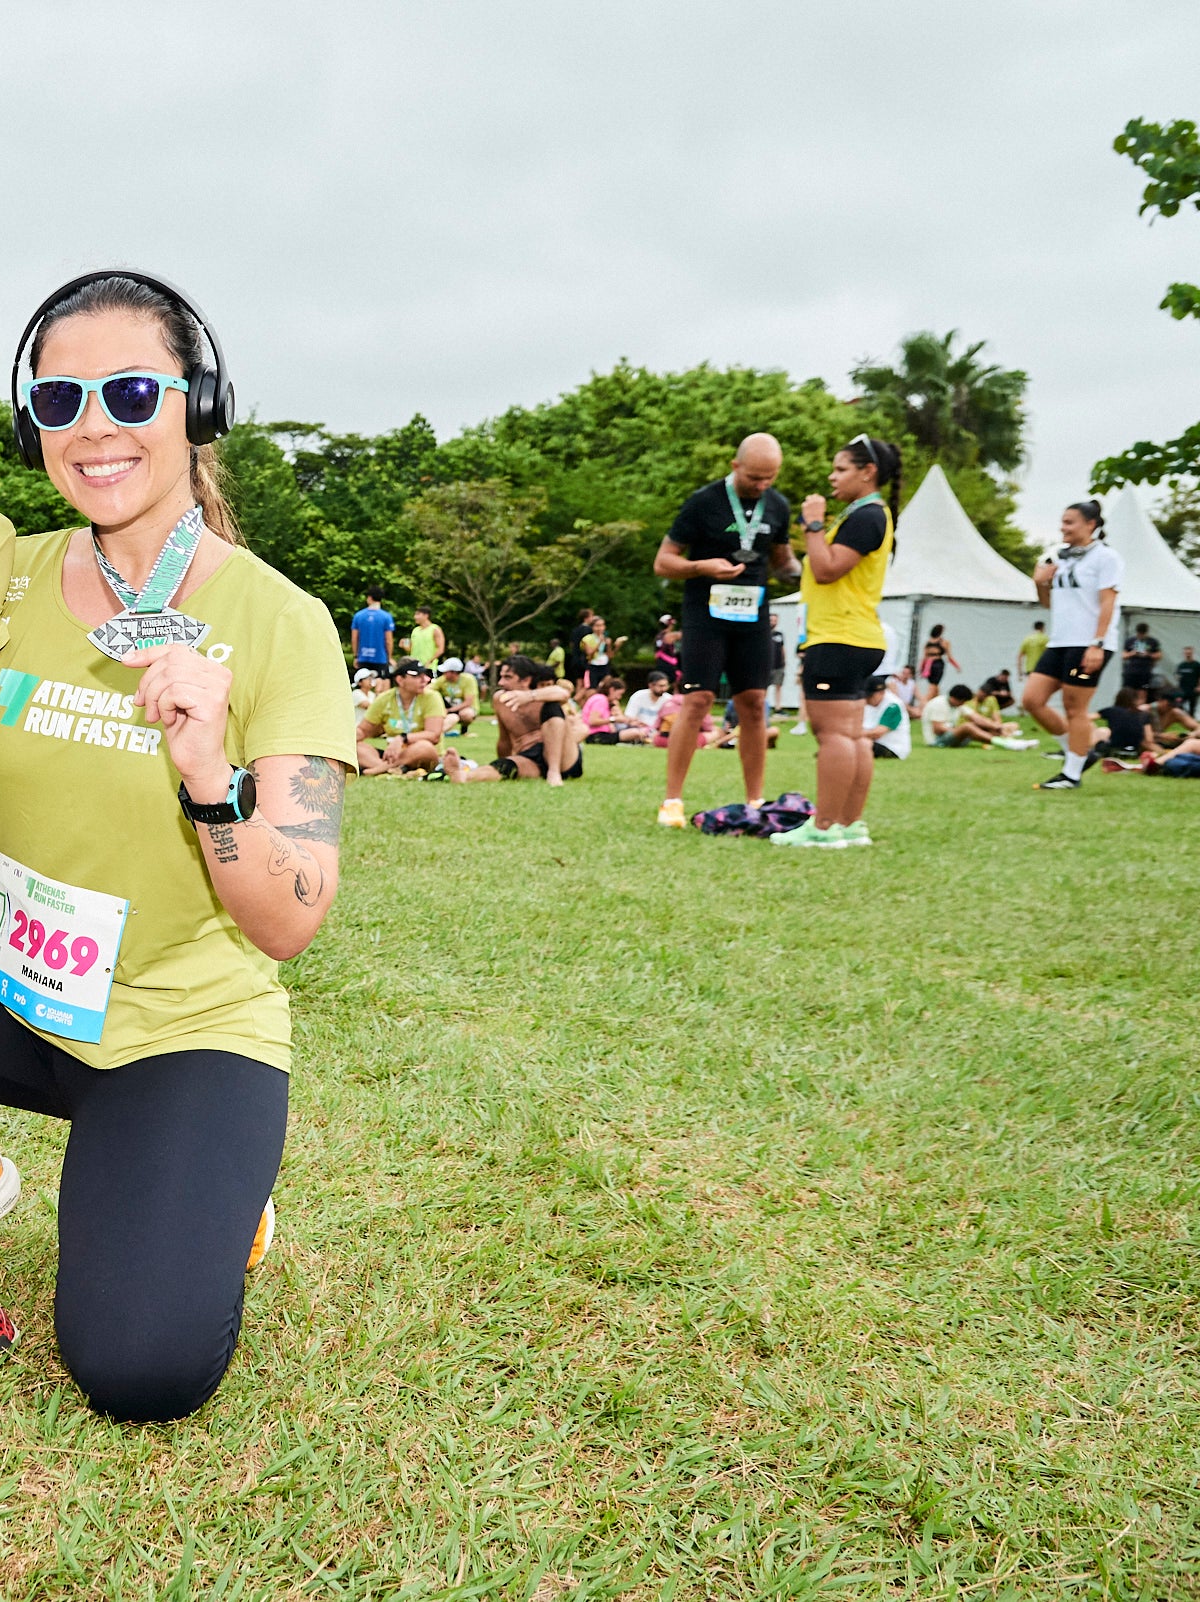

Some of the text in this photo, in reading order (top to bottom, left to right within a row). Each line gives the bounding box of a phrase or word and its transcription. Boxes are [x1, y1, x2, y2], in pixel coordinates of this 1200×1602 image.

[141, 618, 172, 628] ATHENAS
[155, 625, 181, 636] FASTER
[31, 680, 135, 719] ATHENAS
[23, 706, 162, 756] RUN FASTER
[34, 881, 67, 901] ATHENAS
[33, 894, 76, 915] RUN FASTER
[8, 909, 99, 977] 2969
[21, 964, 64, 992] MARIANA
[46, 1014, 73, 1026] SPORTS
